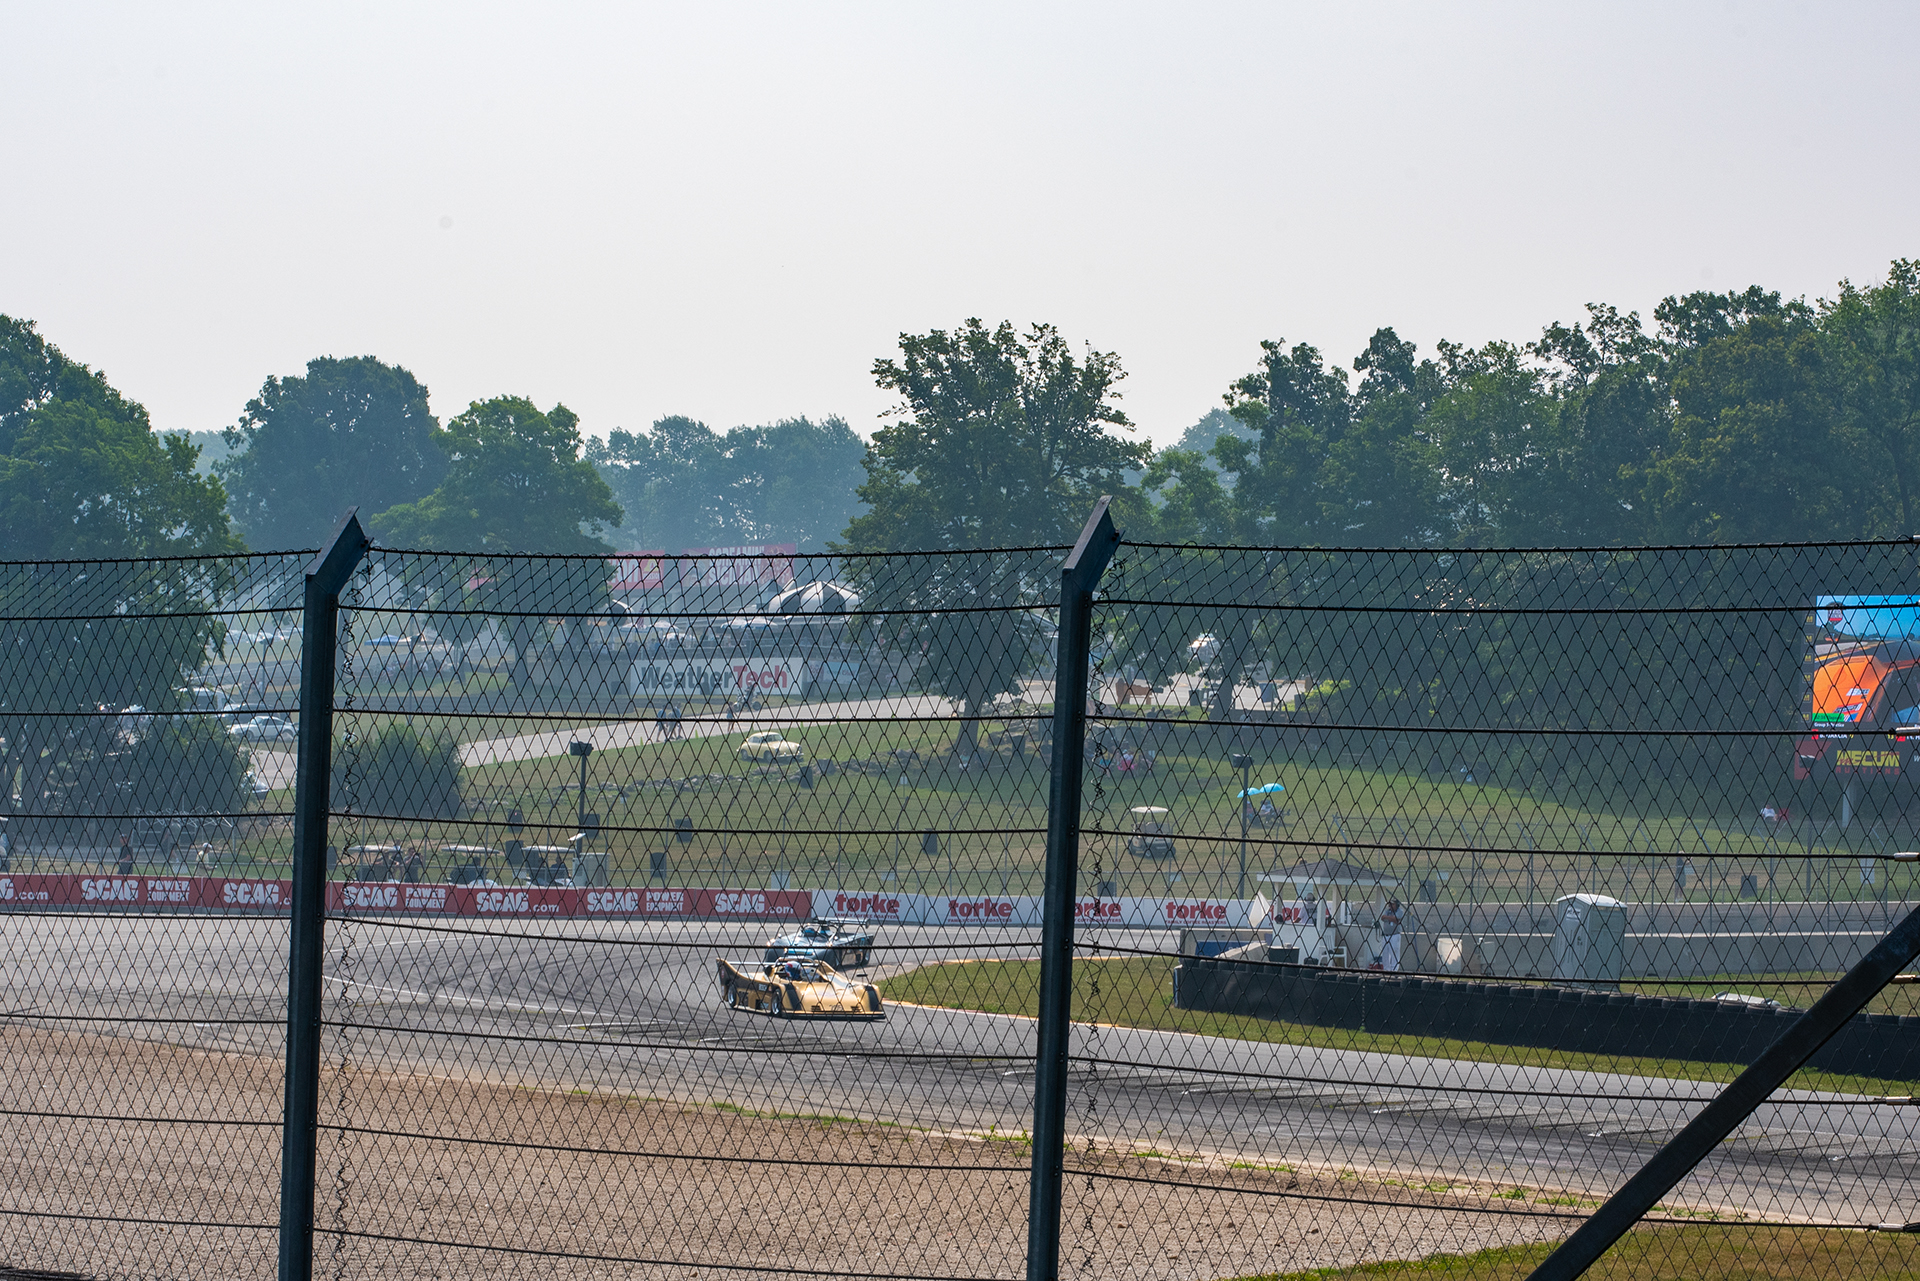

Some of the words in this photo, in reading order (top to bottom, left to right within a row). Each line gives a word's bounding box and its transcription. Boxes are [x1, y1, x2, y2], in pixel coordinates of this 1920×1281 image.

[641, 665, 788, 690] WeatherTech
[1836, 750, 1900, 767] MECUM
[1835, 766, 1900, 775] AUTINS
[81, 878, 139, 901] SCAG
[147, 880, 190, 892] POWER
[405, 887, 446, 899] POWER
[343, 886, 398, 908] SCAG
[405, 898, 446, 909] EQUIPMENT
[587, 891, 638, 912] SCAG
[646, 891, 684, 902] POWER
[835, 893, 900, 914] torke
[646, 902, 684, 912] EQUIPMENT
[949, 898, 1013, 917] torke
[1075, 899, 1122, 917] orke
[1166, 901, 1226, 919] torke
